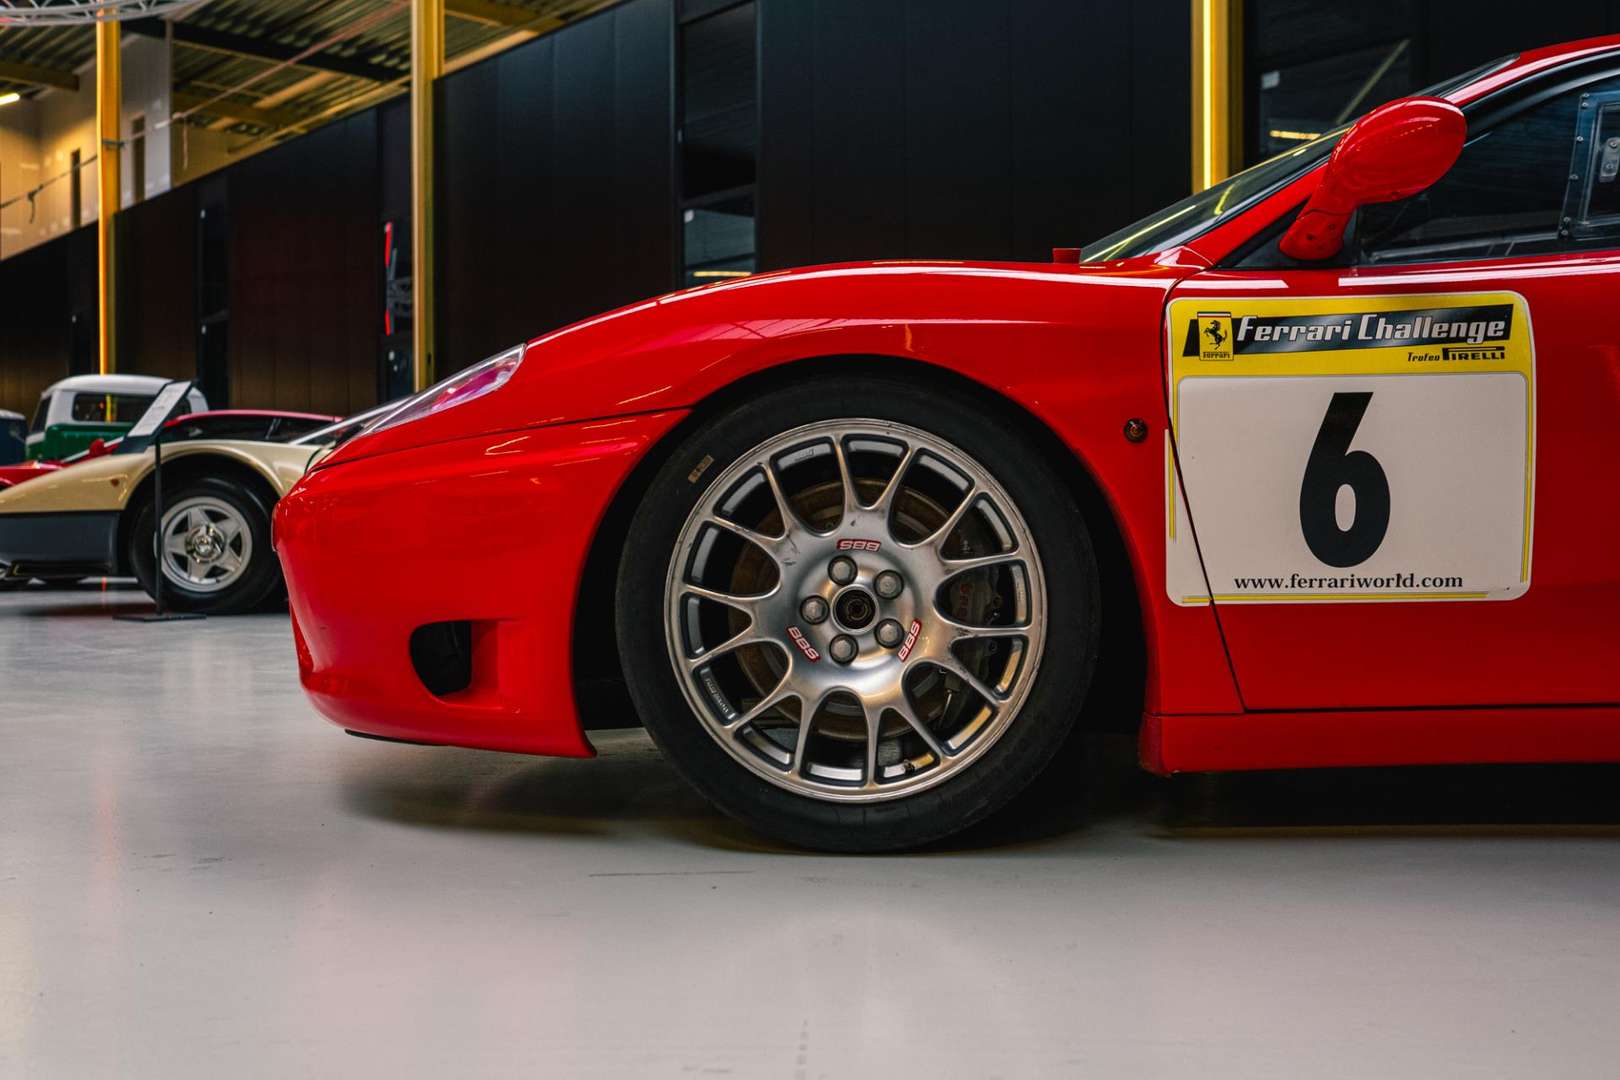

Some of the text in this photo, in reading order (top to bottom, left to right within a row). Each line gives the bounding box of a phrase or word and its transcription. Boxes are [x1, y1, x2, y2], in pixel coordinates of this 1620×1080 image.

[1237, 313, 1506, 345] Ferrari Challenge
[1407, 346, 1506, 362] Trofeo PIRELLI
[1299, 391, 1391, 568] 6
[838, 540, 881, 552] BBS
[1234, 572, 1463, 590] www.ferrariworld.com
[787, 626, 820, 661] BBS
[898, 620, 922, 662] BBS
